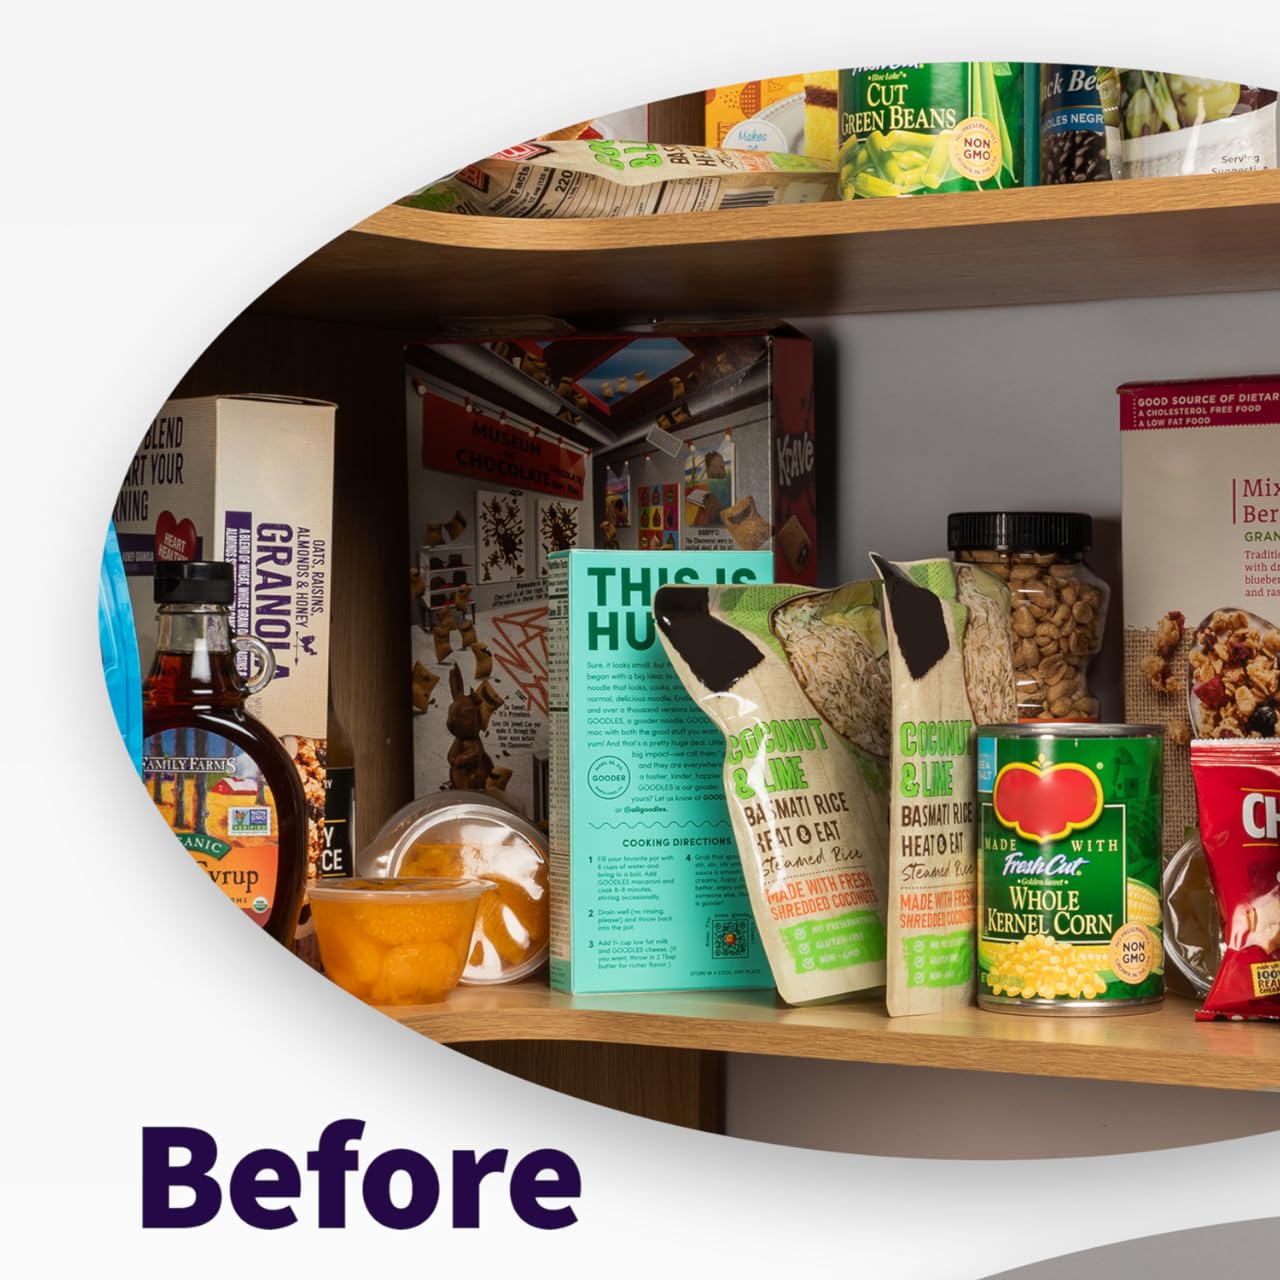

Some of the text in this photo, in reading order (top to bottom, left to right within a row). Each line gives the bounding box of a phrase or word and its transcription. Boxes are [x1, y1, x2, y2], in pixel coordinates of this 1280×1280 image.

[866, 82, 909, 107] CUT
[841, 105, 957, 136] GREEN BEANS
[737, 129, 768, 144] Makes
[963, 138, 991, 149] NON
[963, 149, 991, 161] GMO
[555, 169, 573, 193] 220
[1138, 397, 1169, 408] GOOD
[1171, 394, 1217, 407] SOURCE
[1219, 393, 1236, 404] OF
[1146, 404, 1262, 416] CHOLESTEROL FREE FOOD
[1146, 416, 1212, 427] LOW FAT FOOD
[471, 420, 541, 457] MUSEUM
[151, 452, 184, 485] YOUR
[456, 448, 551, 487] CHOCOLATE
[164, 532, 187, 553] HEART
[295, 526, 311, 628] ALMONDS HONEY
[311, 539, 325, 616] OATS, RAISINS,
[1244, 561, 1268, 573] with
[1244, 586, 1264, 598] and
[727, 717, 829, 765] COCONUT
[900, 719, 973, 758] COCONUT
[188, 756, 237, 774] FARMS
[732, 767, 757, 800] &
[900, 761, 954, 798] & LIME
[744, 791, 850, 827] BASMATI RICE
[901, 801, 973, 827] BASMATI RICE
[622, 837, 732, 848] COOKING DIRECTIONS
[815, 820, 843, 843] EAT
[901, 832, 964, 857] HEAT EAT
[984, 838, 1119, 853] MADE WITH
[762, 849, 826, 878] Steamed
[902, 859, 951, 882] Steamed
[1002, 851, 1047, 877] Fresh
[766, 871, 873, 904] MADE WITH FRESH
[1009, 885, 1080, 912] WHOLE
[770, 888, 880, 922] SHREDDED COCONUTS
[900, 891, 953, 912] MADE WITH
[900, 911, 947, 930] SHREDDED
[987, 907, 1114, 936] KERNEL CORN
[1122, 941, 1146, 953] NON
[1122, 952, 1146, 964] GMO
